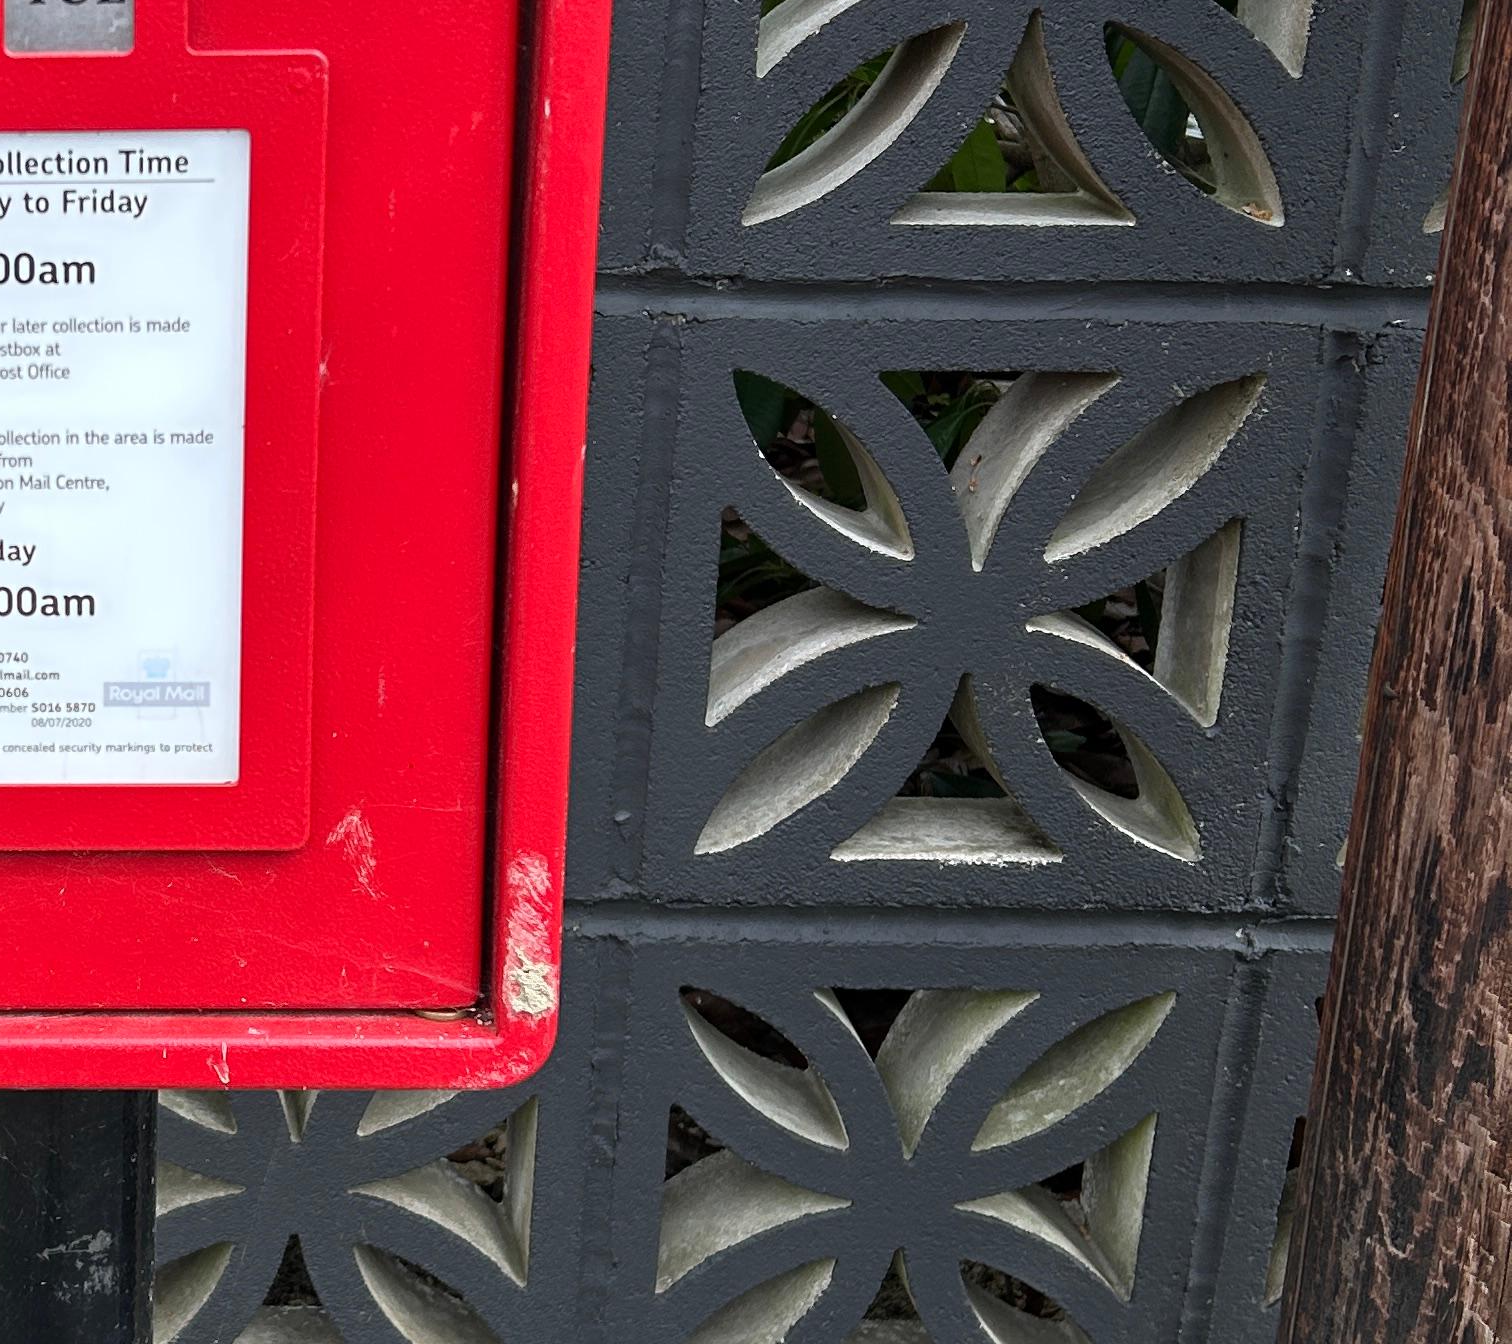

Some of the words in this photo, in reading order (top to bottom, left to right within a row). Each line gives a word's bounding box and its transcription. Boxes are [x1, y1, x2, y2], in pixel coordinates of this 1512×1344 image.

[118, 150, 189, 174] Time
[24, 192, 49, 214] to
[62, 190, 148, 217] Friday
[12, 319, 47, 334] later
[53, 318, 124, 333] collection
[129, 318, 141, 333] is
[146, 317, 190, 332] made
[46, 342, 60, 356] at
[28, 364, 70, 379] Office
[66, 430, 79, 445] in
[85, 430, 109, 445] the
[115, 433, 148, 445] area
[154, 430, 165, 444] is
[171, 429, 213, 444] made
[20, 475, 50, 490] Mail
[56, 475, 110, 492] Centre,
[109, 685, 160, 704] Royal
[165, 685, 205, 701] Mail
[31, 718, 92, 728] 08/07/2020
[3, 743, 55, 753] concealed
[59, 743, 101, 755] security
[106, 743, 155, 754] markings
[159, 744, 170, 752] to
[174, 743, 213, 755] protect
